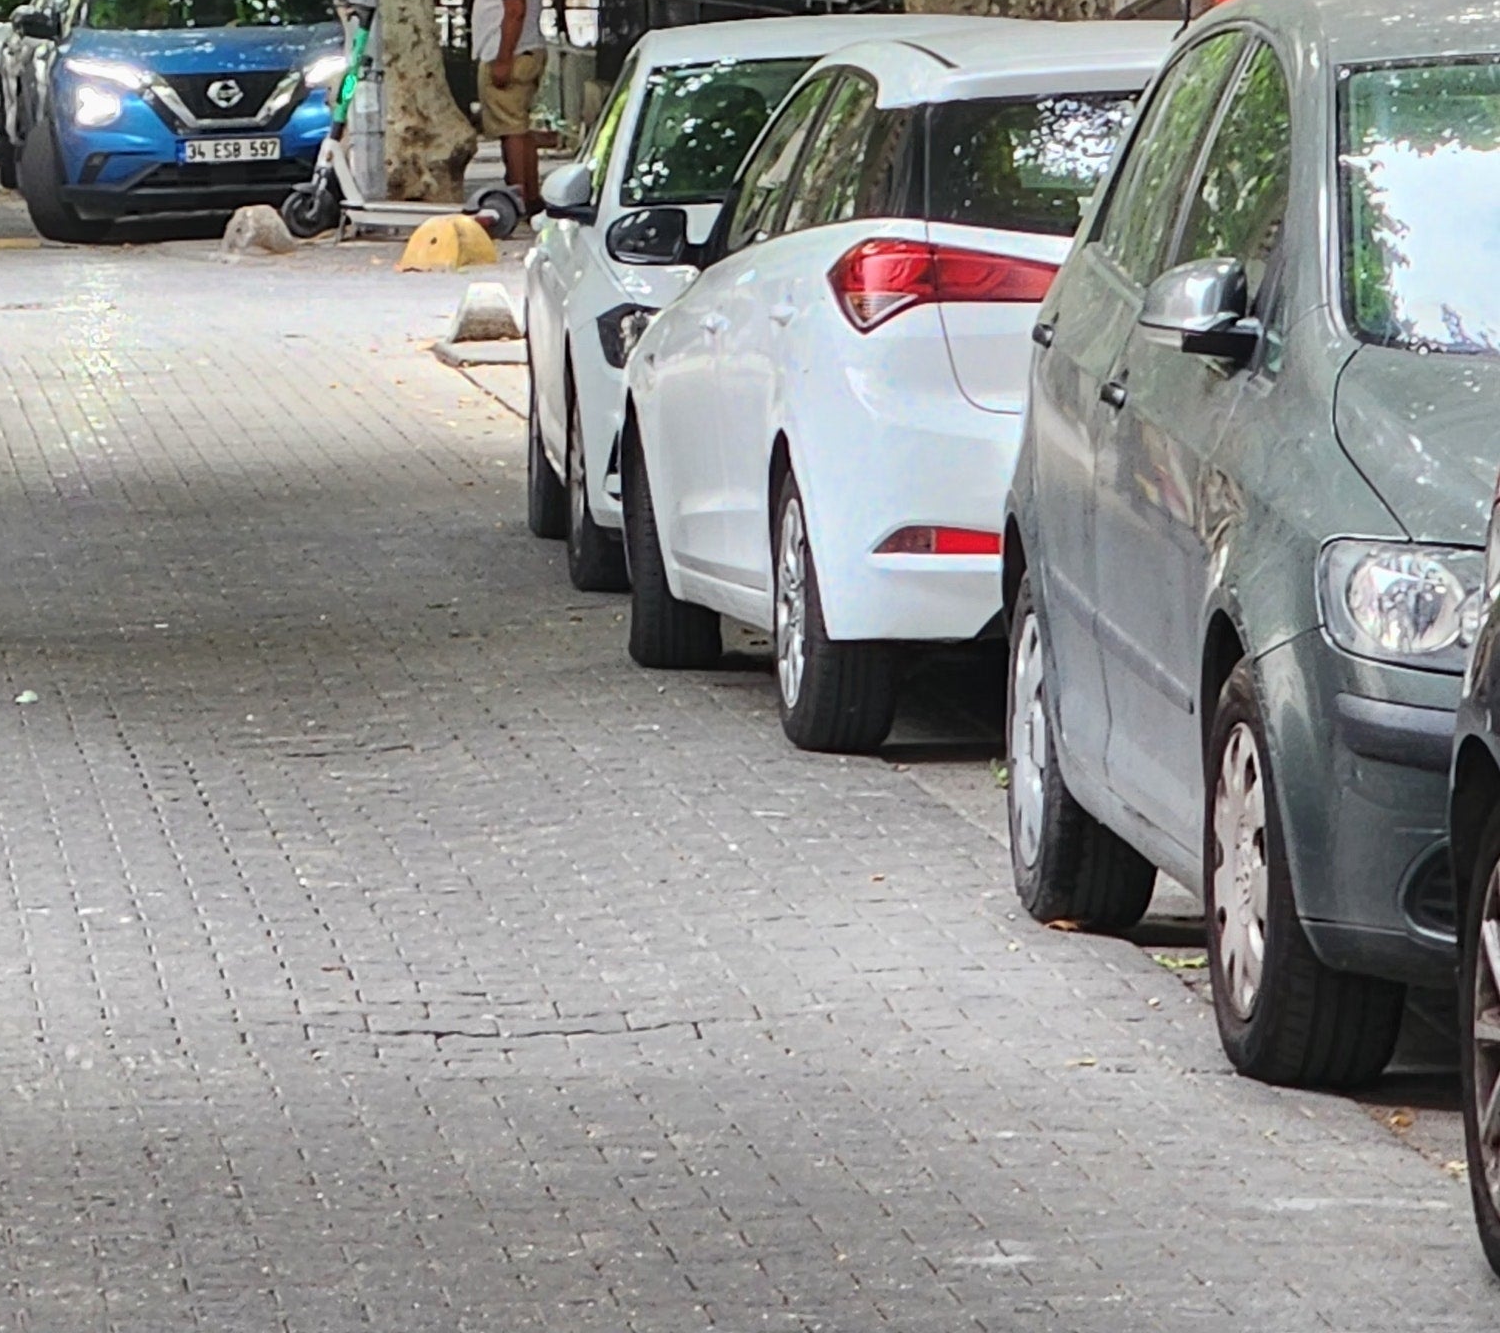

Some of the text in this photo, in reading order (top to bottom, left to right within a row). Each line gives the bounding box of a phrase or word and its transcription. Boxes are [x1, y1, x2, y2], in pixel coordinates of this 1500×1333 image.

[187, 140, 278, 160] 34 ESB 597
